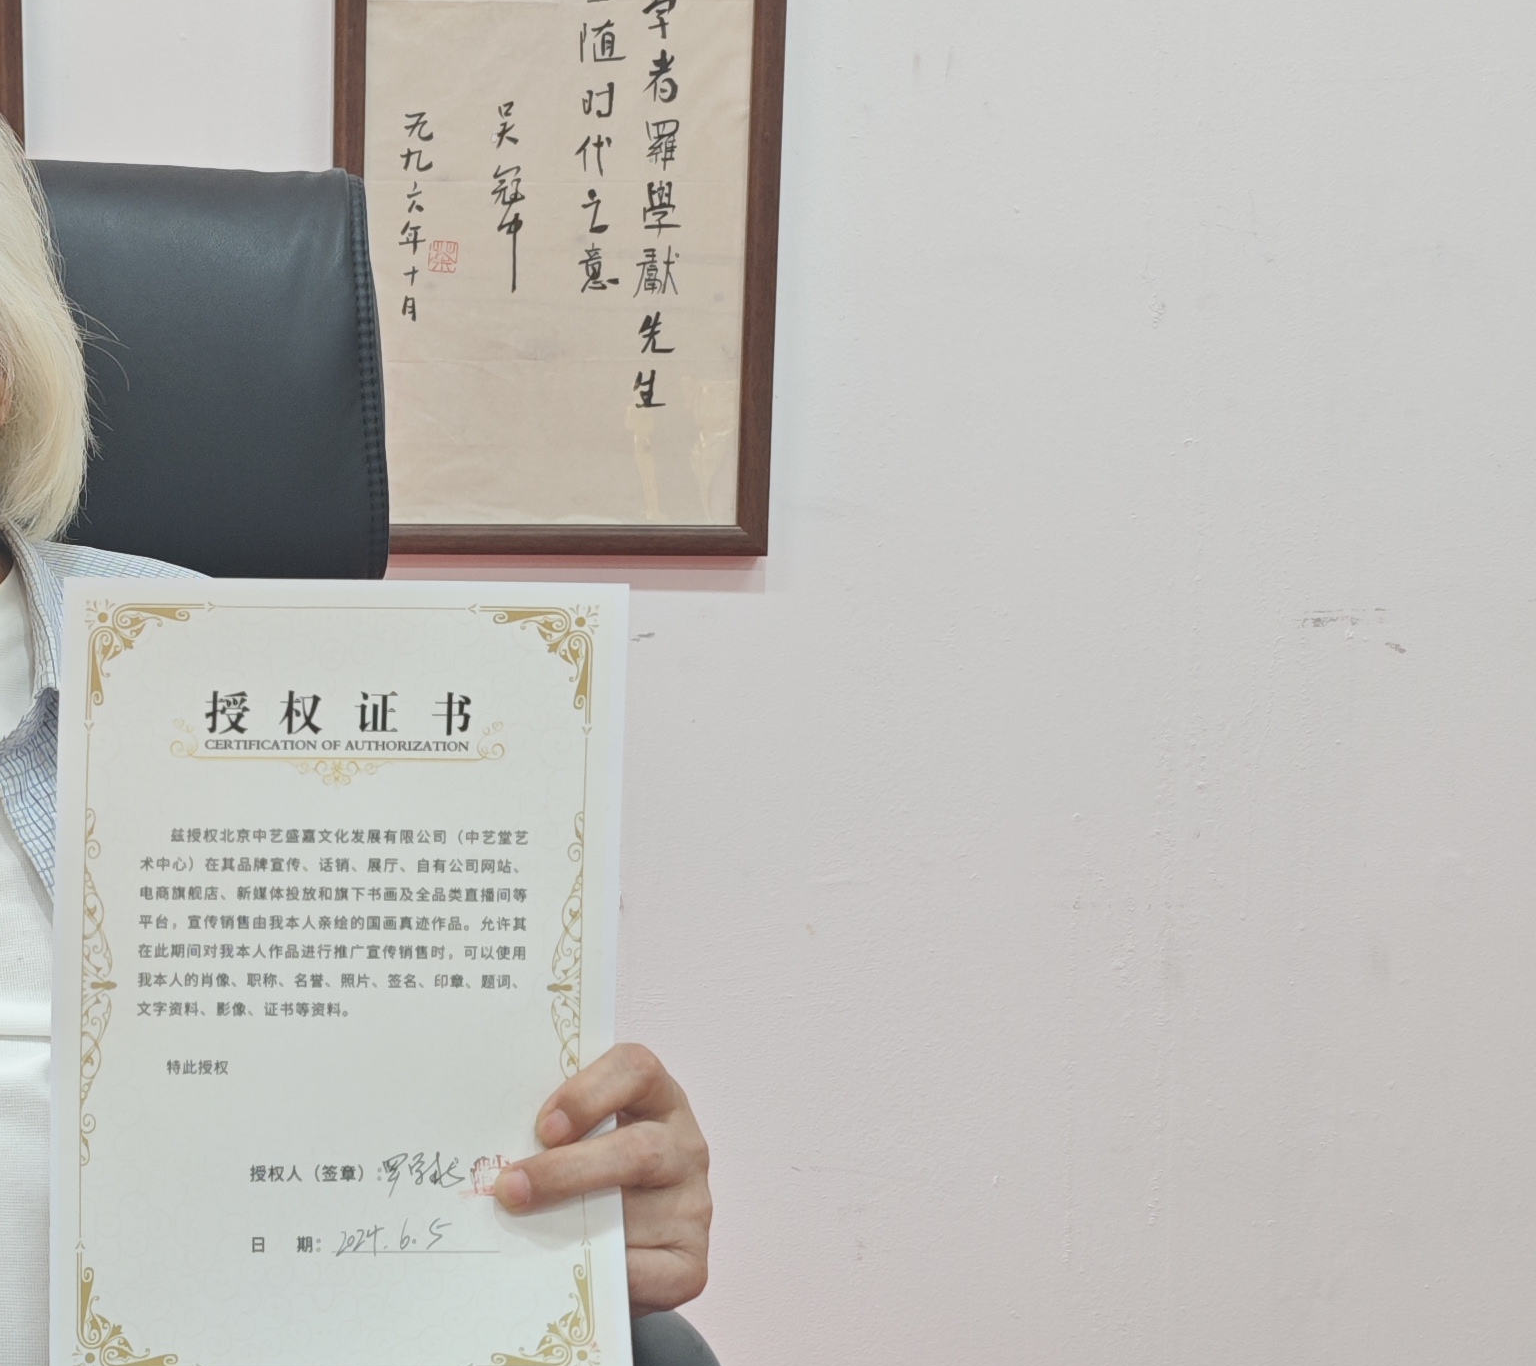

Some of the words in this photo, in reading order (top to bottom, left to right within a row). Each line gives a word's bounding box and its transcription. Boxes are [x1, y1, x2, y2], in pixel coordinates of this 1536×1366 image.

[205, 690, 471, 736] 授权证书
[205, 739, 317, 751] CERTIFICATION
[321, 740, 341, 751] OF
[345, 740, 469, 752] AUTHORIZATION
[167, 1059, 228, 1075] 特此授权
